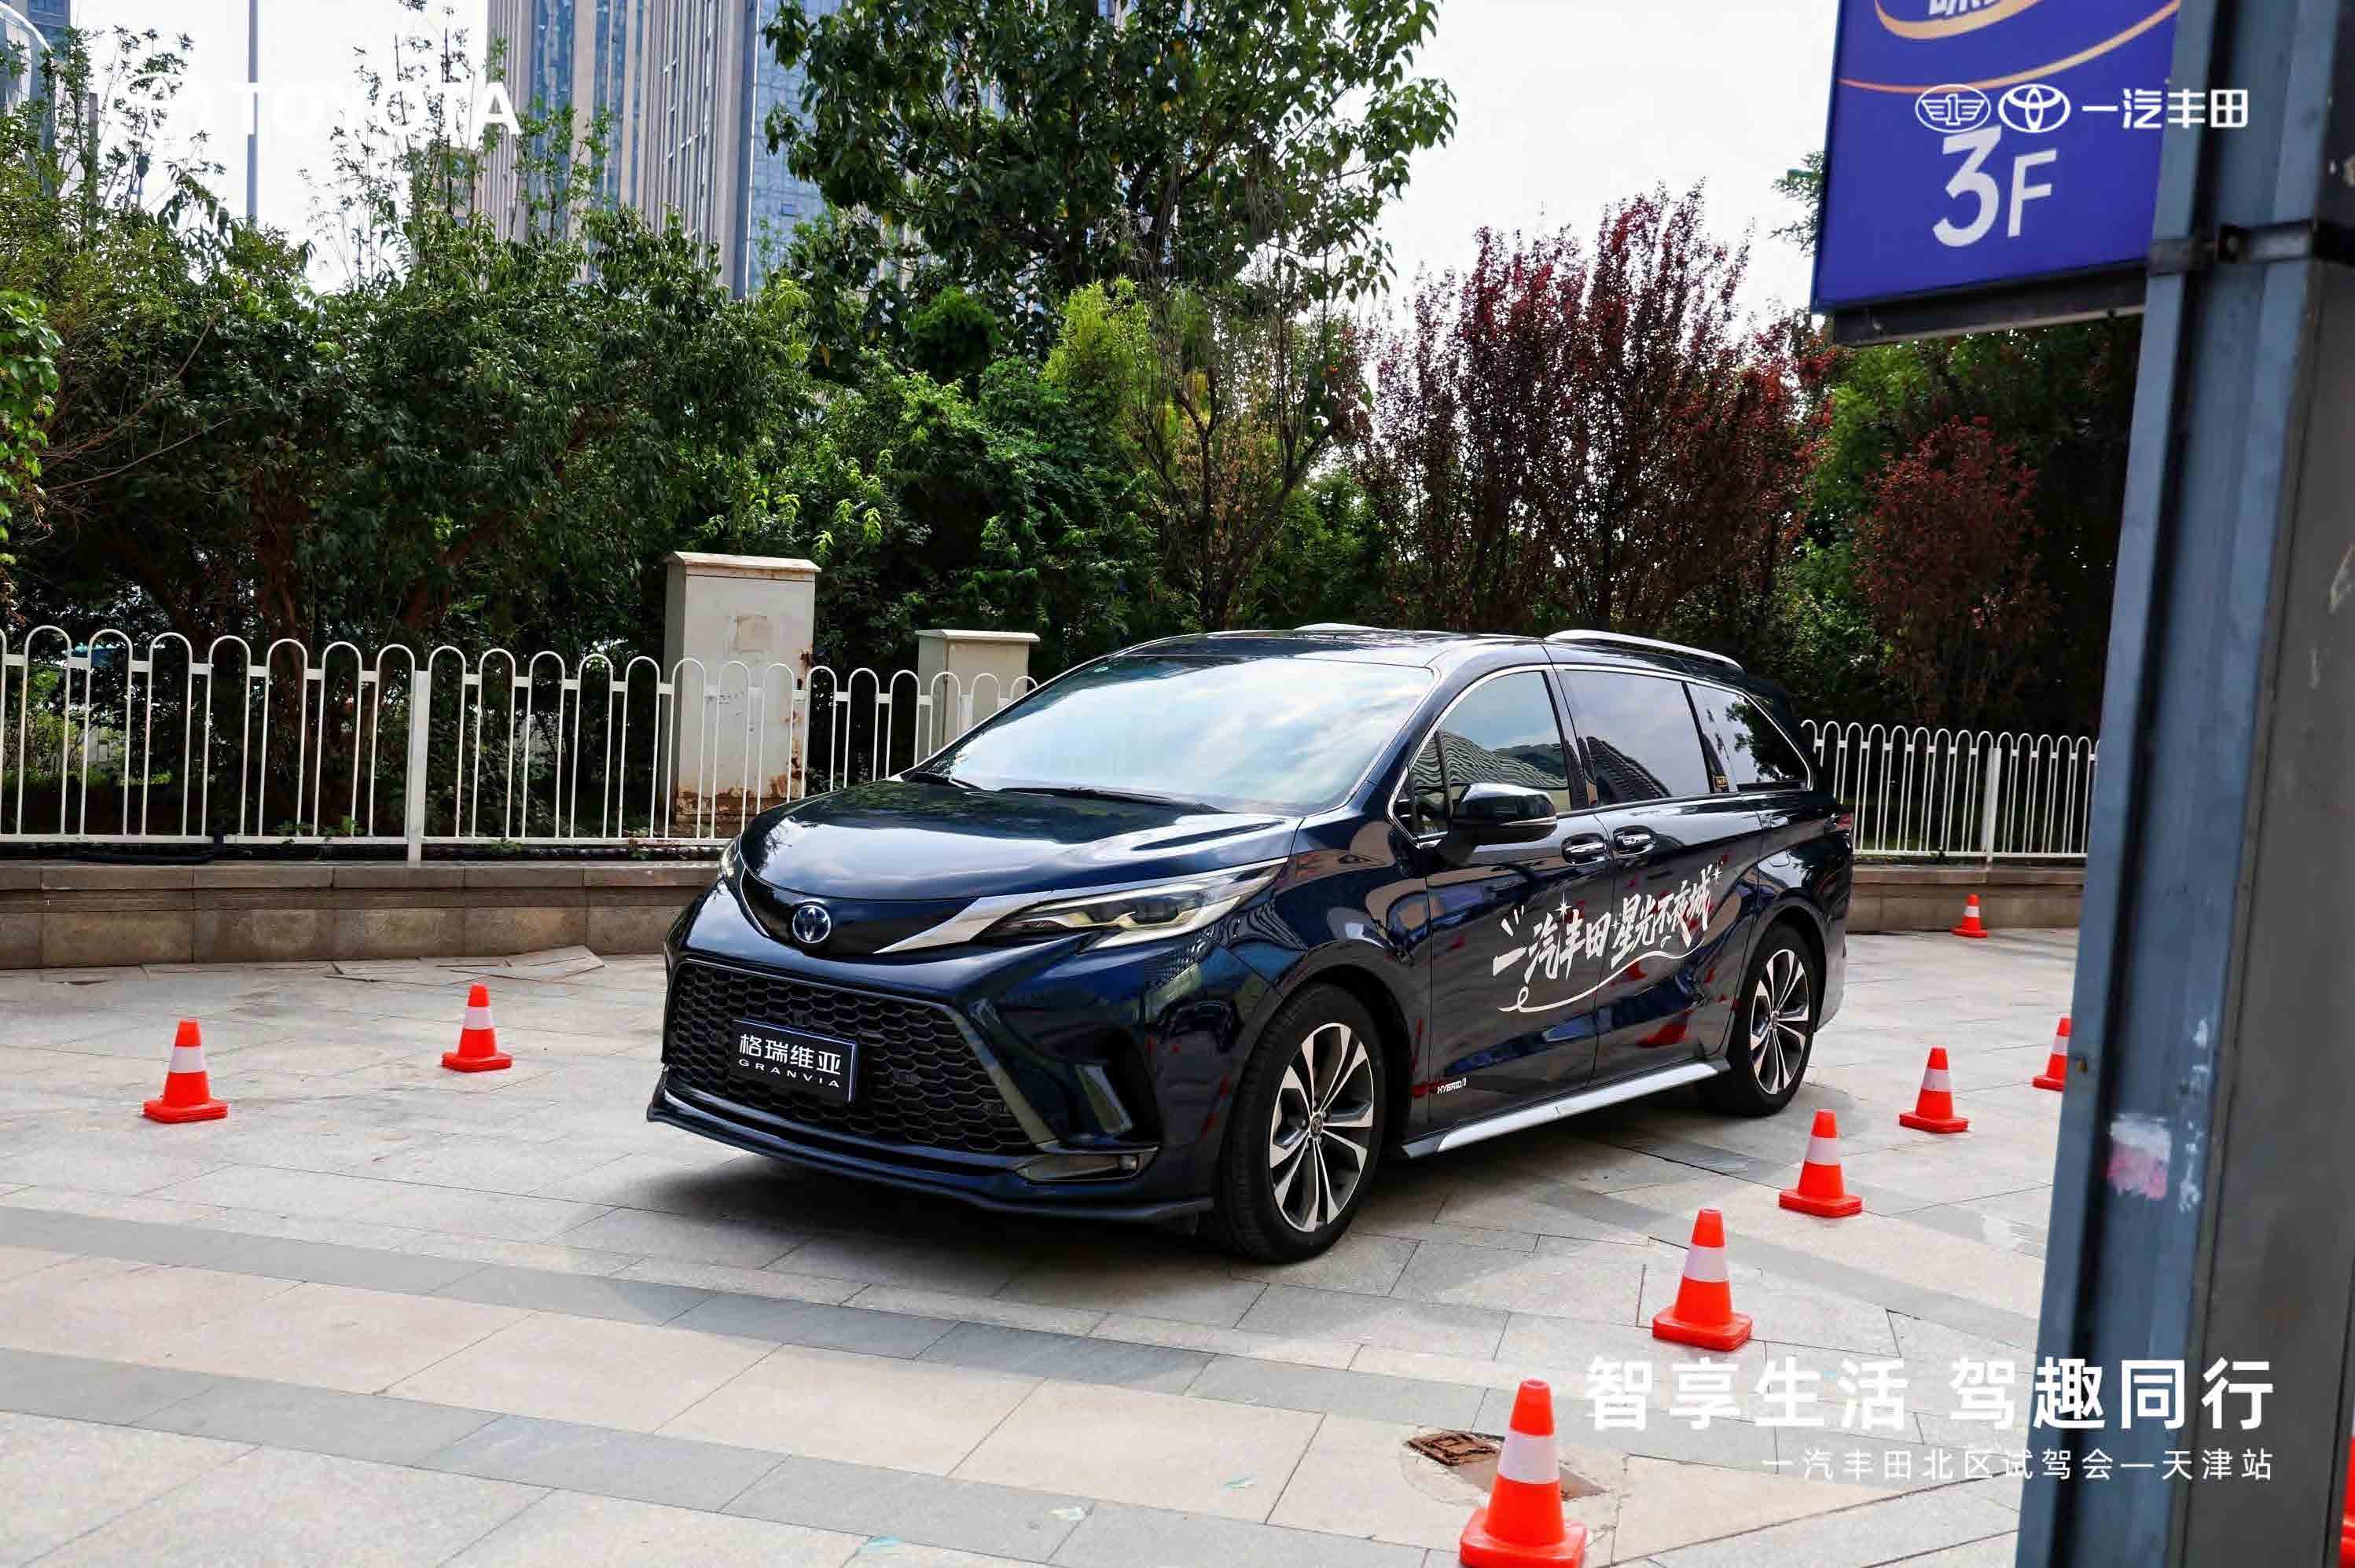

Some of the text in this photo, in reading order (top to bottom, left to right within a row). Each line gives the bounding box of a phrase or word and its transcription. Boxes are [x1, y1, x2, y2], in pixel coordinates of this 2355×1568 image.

[1932, 125, 2057, 247] 3F
[738, 1059, 839, 1088] GRANVIA
[739, 1034, 841, 1075] 格瑞维亚
